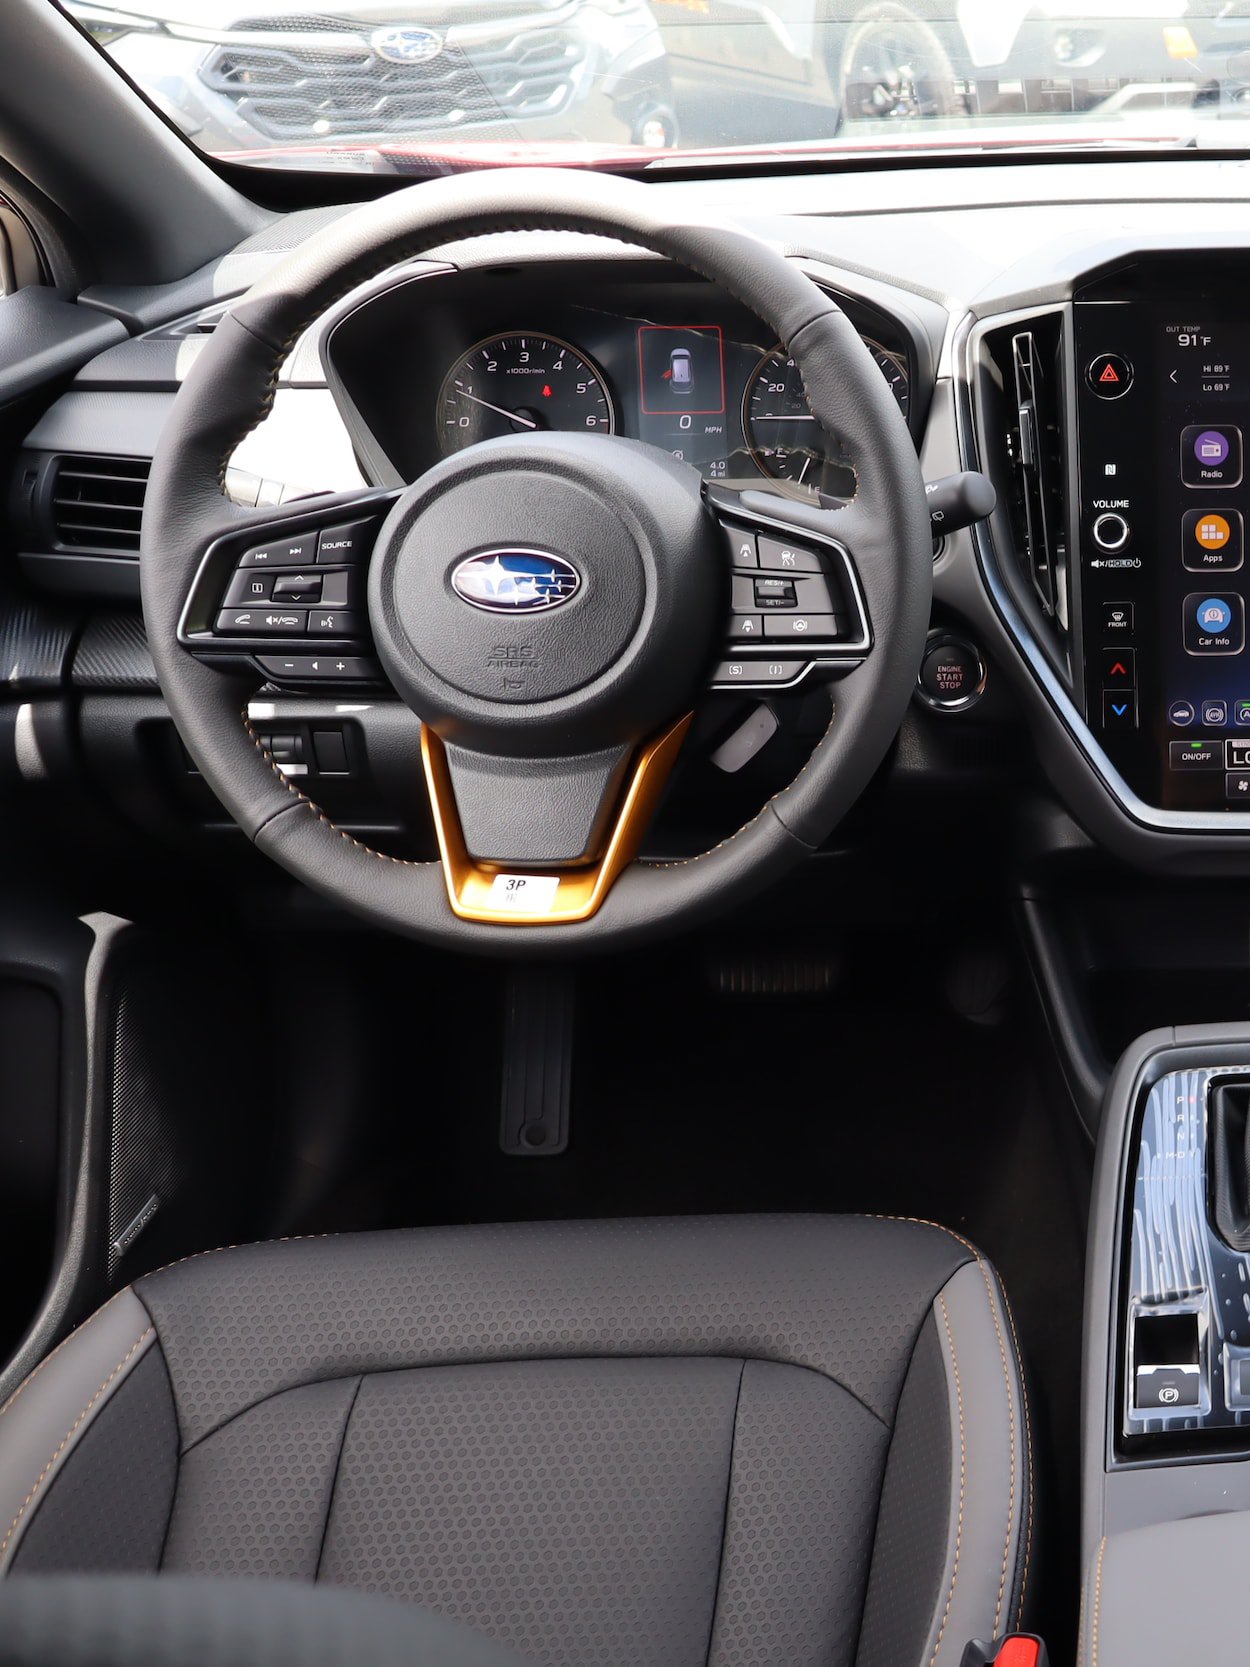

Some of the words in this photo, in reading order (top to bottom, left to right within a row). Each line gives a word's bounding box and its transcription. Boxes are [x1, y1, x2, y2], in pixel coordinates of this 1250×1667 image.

[520, 352, 530, 363] 3
[487, 361, 498, 372] 2
[552, 360, 562, 371] 4
[1203, 365, 1212, 373] Hi
[467, 386, 474, 394] 1
[576, 383, 586, 394] 5
[768, 383, 785, 392] 20
[1202, 384, 1212, 392] Lo
[459, 416, 470, 428] 0
[586, 415, 596, 426] 6
[679, 414, 692, 430] 0
[704, 426, 723, 434] MPH
[710, 461, 726, 470] 4.0
[710, 470, 717, 478] 4
[1200, 470, 1223, 478] Radio
[1092, 500, 1130, 509] VOLUME
[321, 540, 353, 550] SOURCE
[1203, 554, 1223, 563] Apps
[1198, 638, 1212, 646] Car
[1215, 637, 1230, 646] Info
[936, 673, 964, 681] START
[1182, 752, 1212, 760] ON/OFF
[506, 879, 526, 891] 3P
[1176, 1096, 1184, 1104] P
[1176, 1114, 1184, 1122] R
[1176, 1132, 1184, 1140] N
